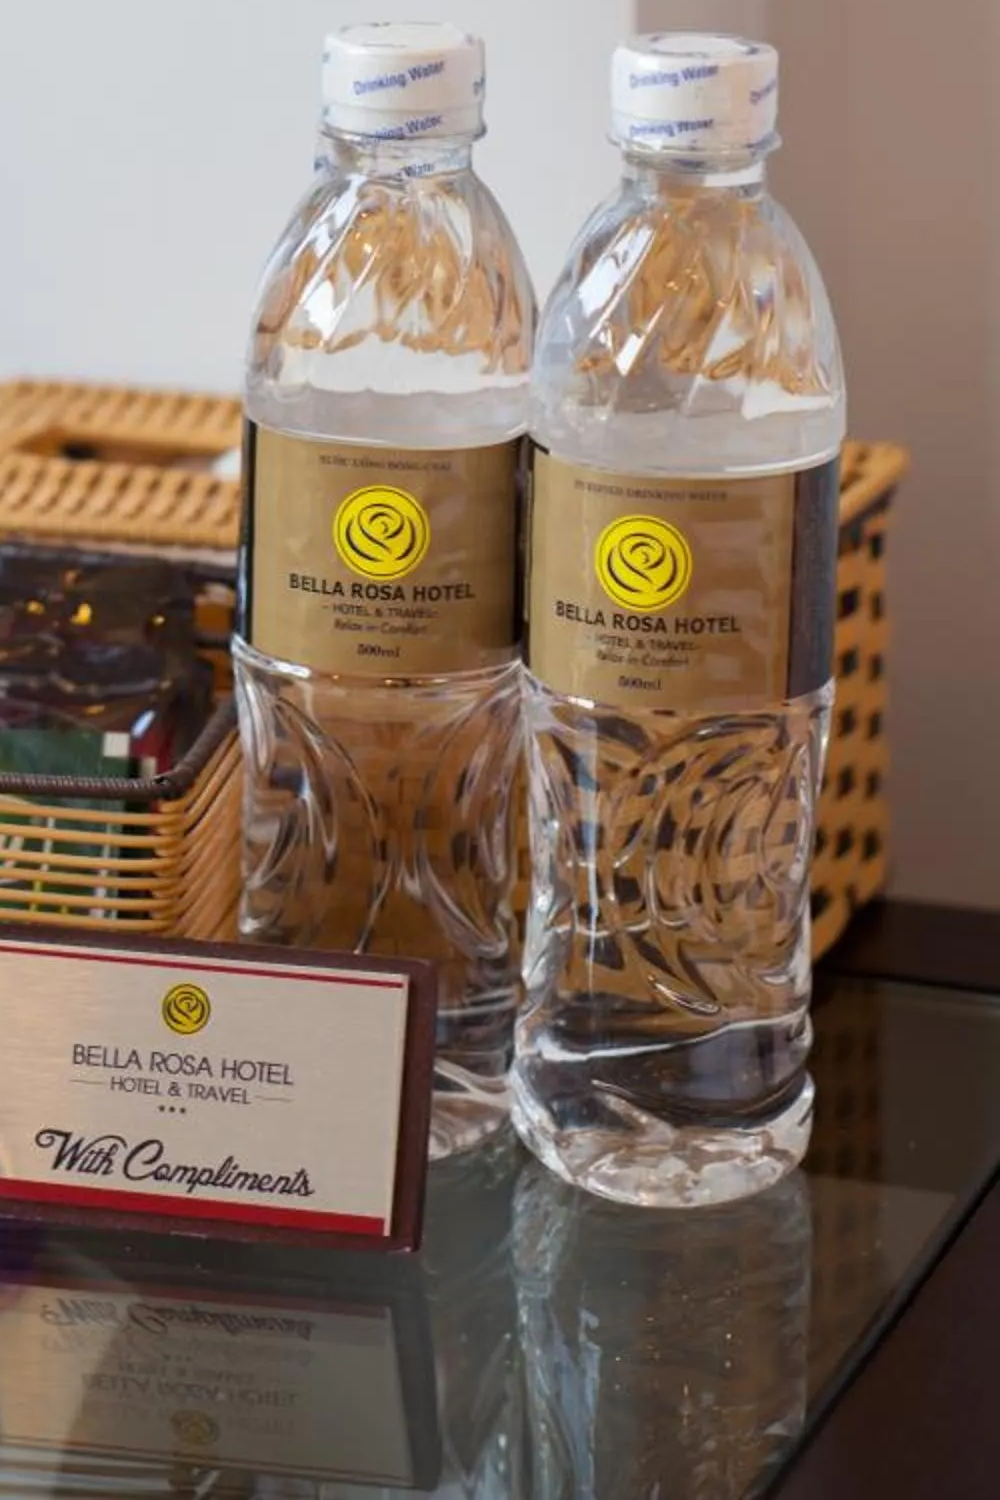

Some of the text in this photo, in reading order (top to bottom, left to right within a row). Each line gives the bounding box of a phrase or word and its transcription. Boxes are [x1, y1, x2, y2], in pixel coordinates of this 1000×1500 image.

[353, 60, 445, 96] Drinking Water
[629, 65, 719, 89] Drinking Water
[405, 115, 443, 134] Water
[289, 572, 475, 602] BELLA ROSA HOTEL
[332, 602, 370, 618] HOTEL
[555, 600, 742, 636] BELLA ROSA HOTEL
[594, 632, 630, 650] HOTEL
[649, 637, 696, 652] TRAVEL
[72, 1043, 294, 1086] BELLA ROSA HOTEL
[110, 1076, 251, 1104] HOTEL & TRAVEL
[35, 1128, 315, 1197] With Compliments
